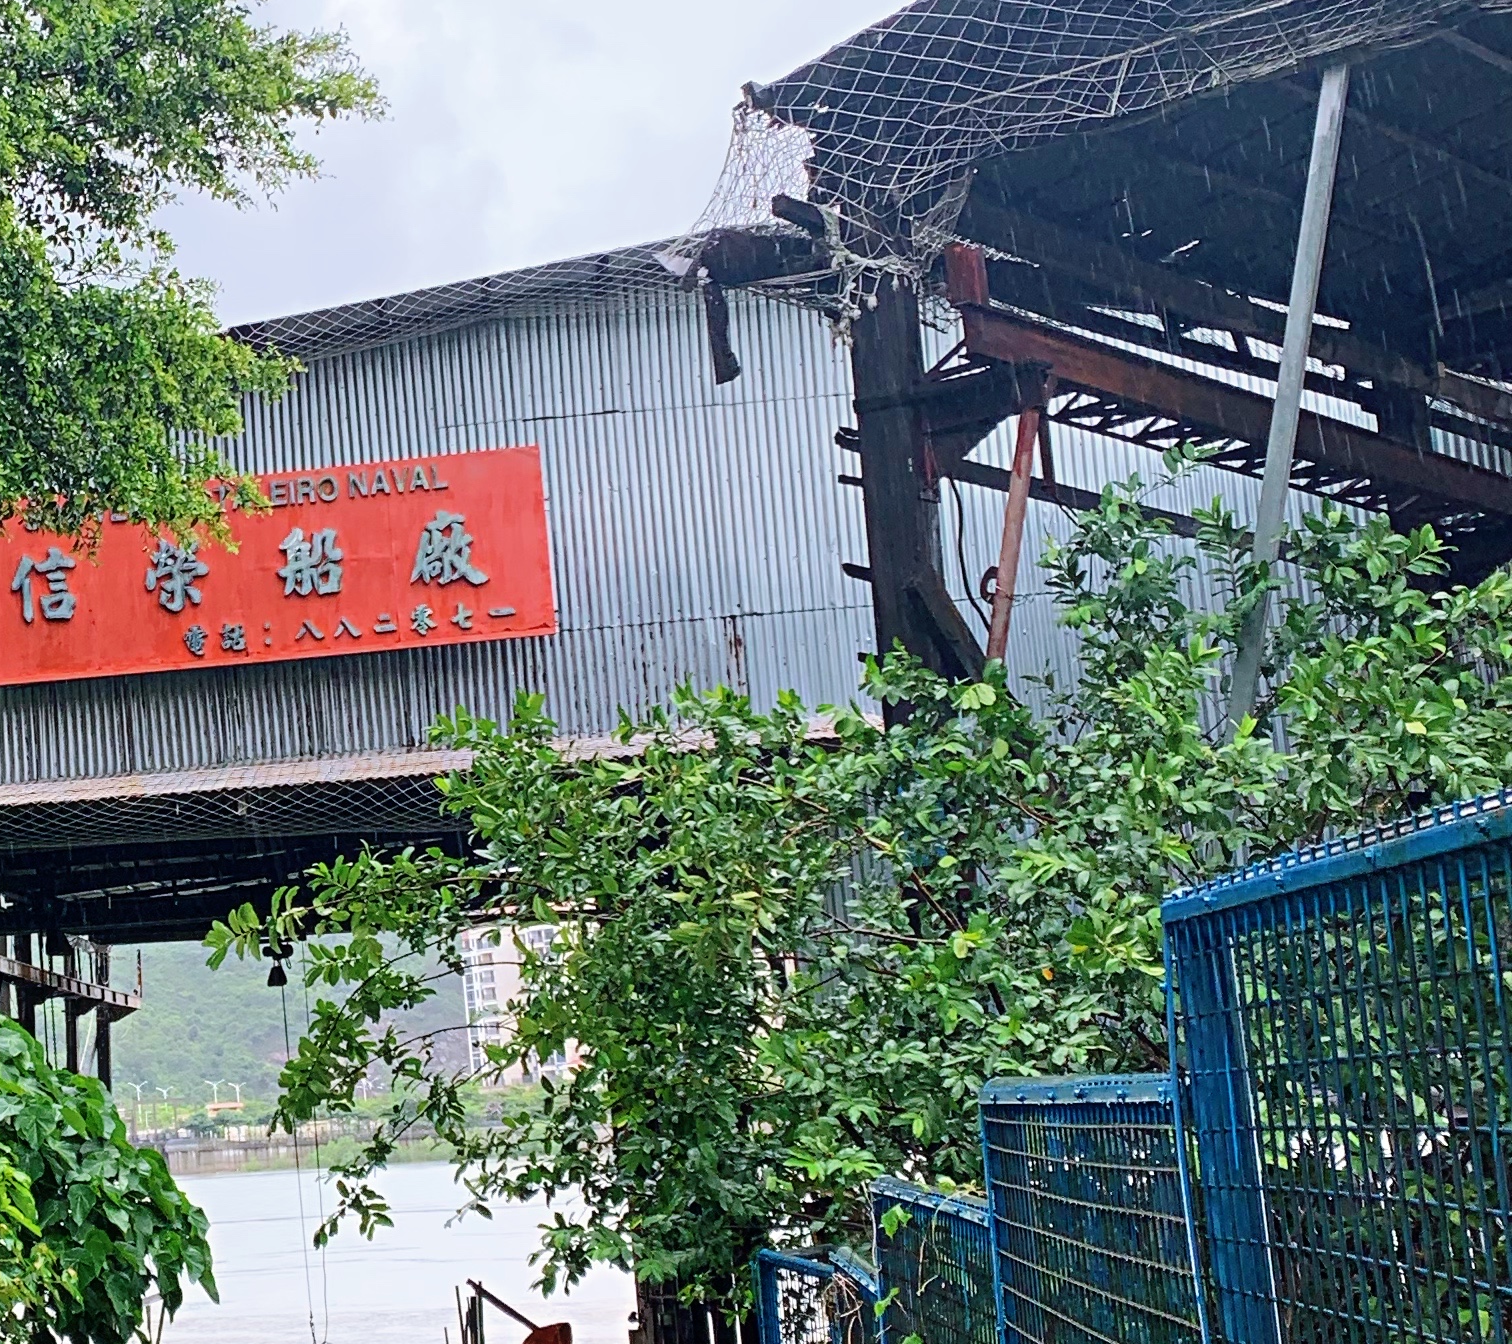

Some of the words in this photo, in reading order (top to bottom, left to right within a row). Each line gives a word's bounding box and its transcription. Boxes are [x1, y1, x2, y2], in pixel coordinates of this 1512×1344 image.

[348, 464, 448, 499] NAVAL
[11, 510, 490, 622] 信榮船廠
